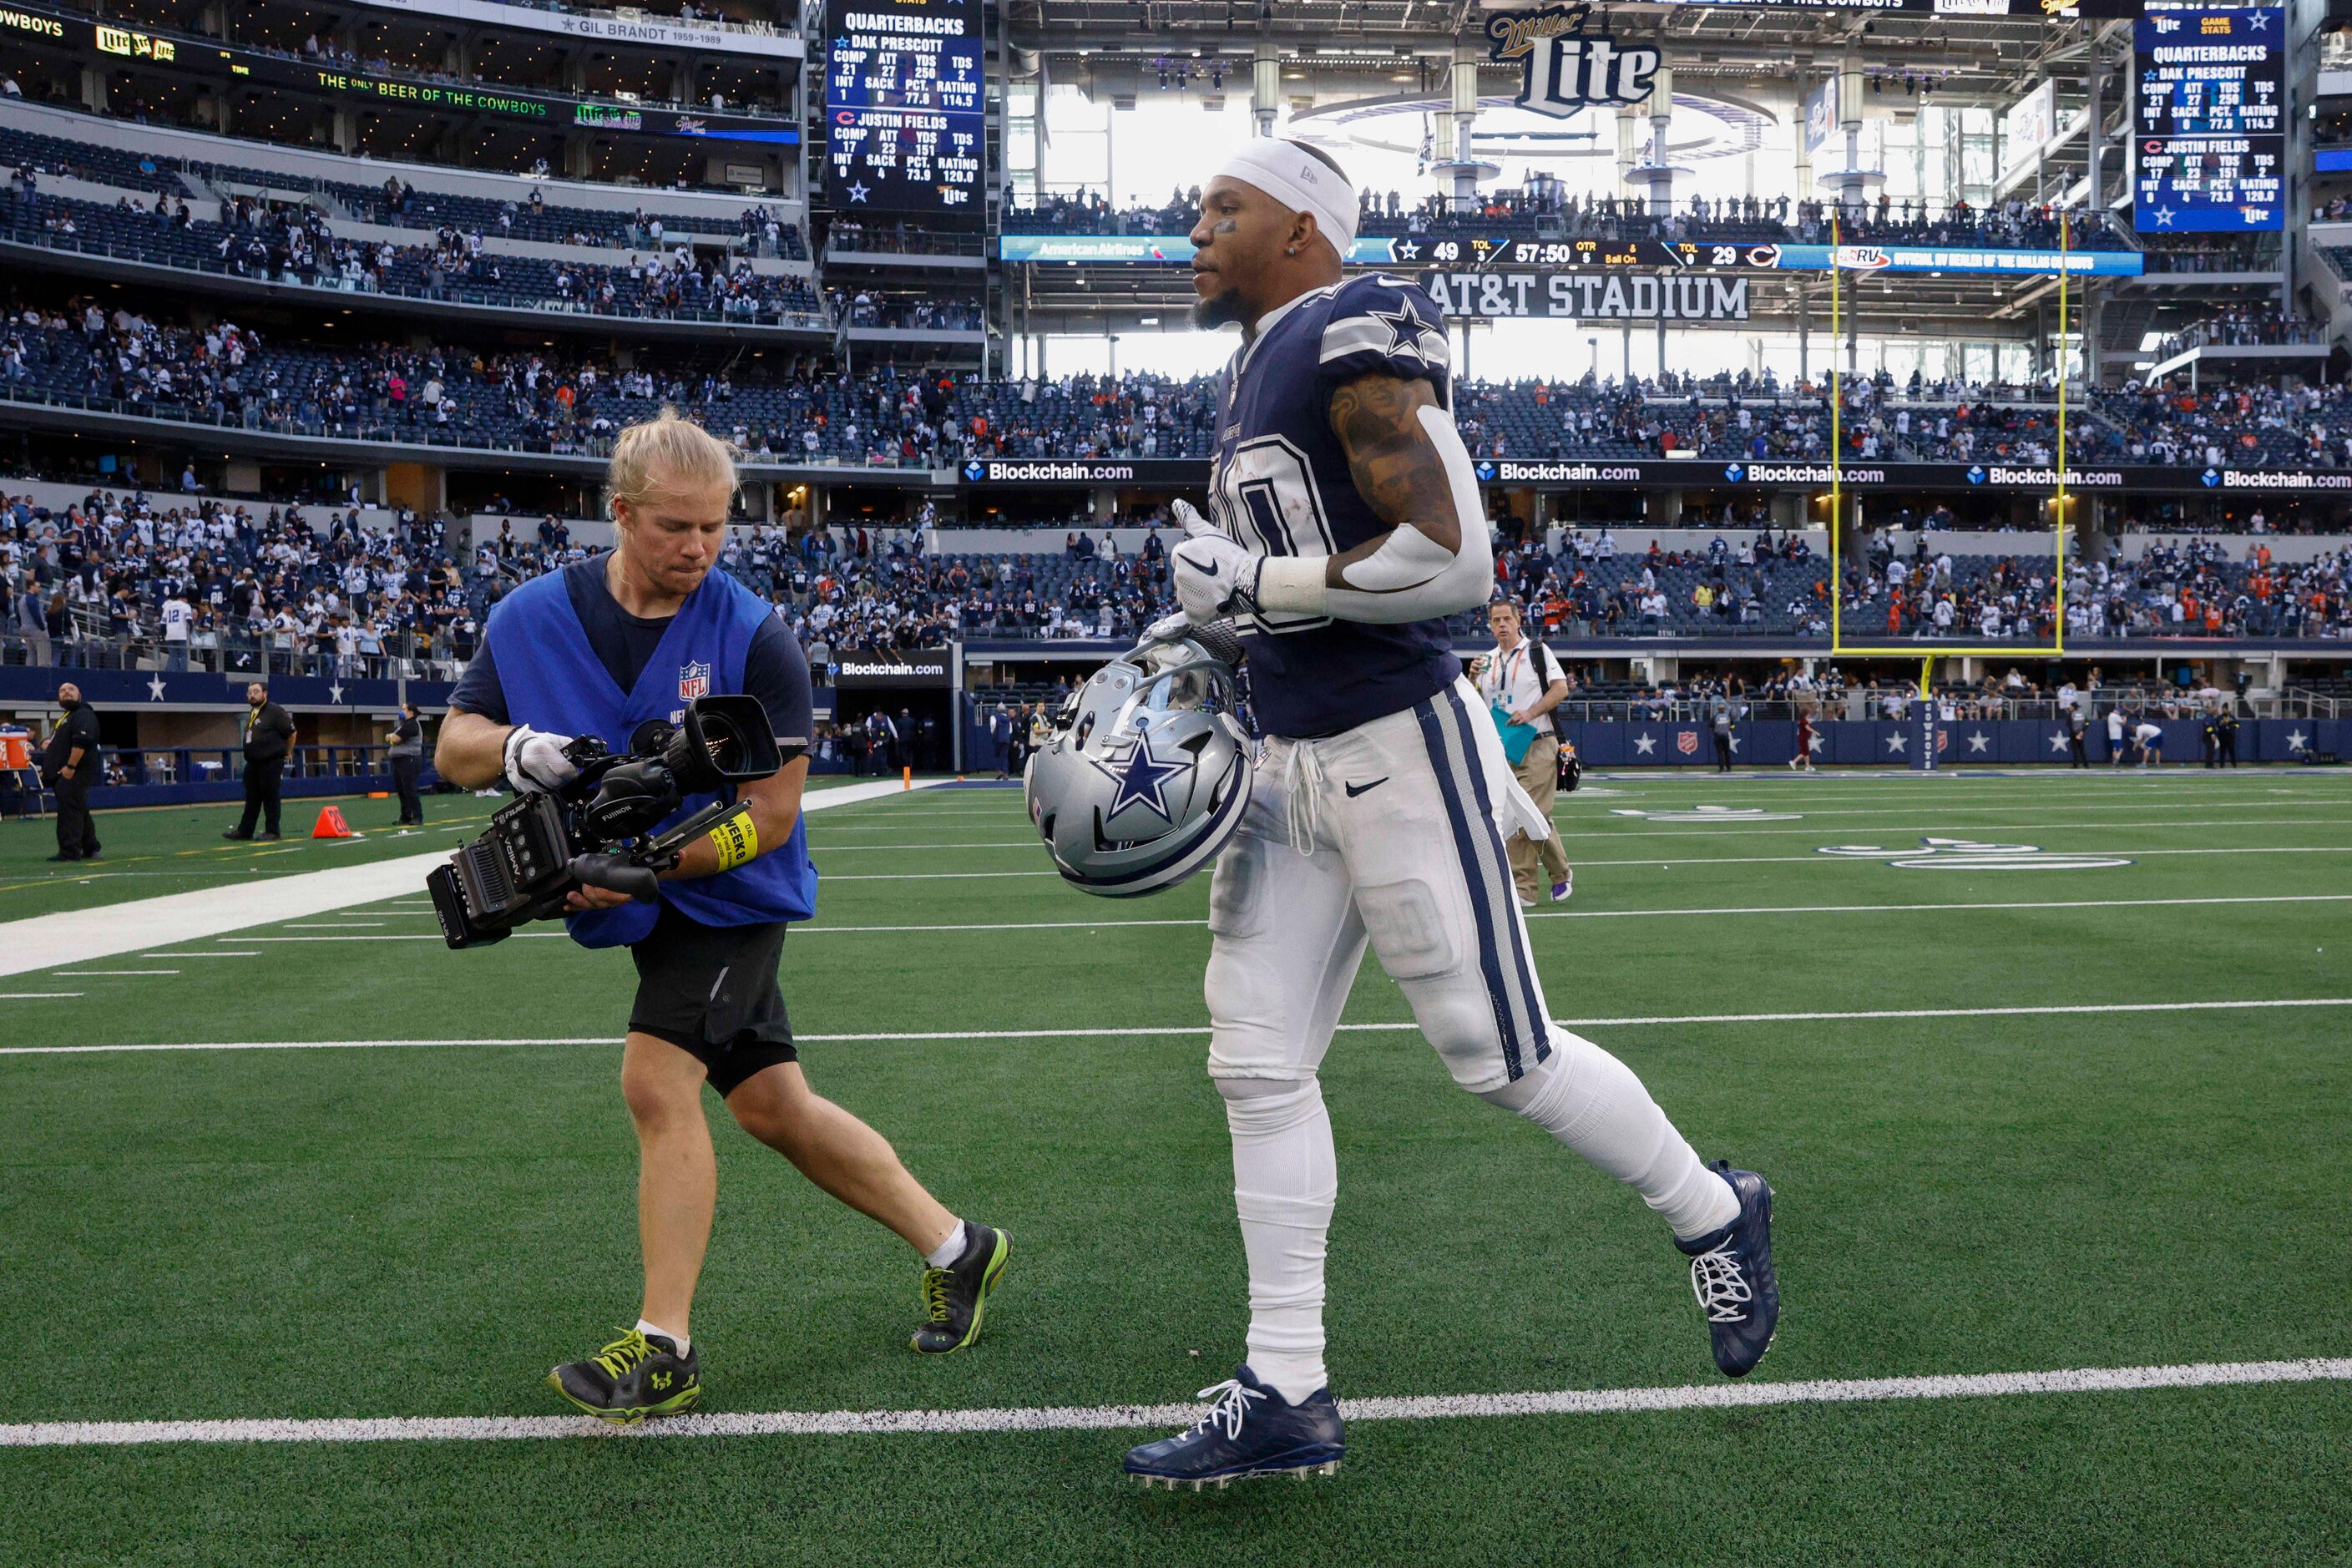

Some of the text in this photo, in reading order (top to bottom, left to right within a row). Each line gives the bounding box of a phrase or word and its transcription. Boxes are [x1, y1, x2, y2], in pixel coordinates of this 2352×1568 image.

[846, 13, 964, 35] QUARTERBACKS
[2157, 19, 2180, 33] Lite
[2201, 18, 2229, 26] GAME
[579, 21, 721, 45] GIL BRANDT 1959-1989
[1491, 13, 1583, 51] Miller
[2201, 26, 2231, 34] STATS
[852, 35, 943, 52] DAK PRESCOTT
[834, 50, 972, 68] COMP ATT YDS TDS
[2153, 46, 2267, 63] QUARTERBACKS
[232, 65, 249, 75] TIME
[842, 64, 965, 80] 21 27 250 2
[1521, 37, 1657, 117] Lite
[2159, 67, 2246, 80] DAK PRESCOTT
[836, 76, 976, 94] INT SACK PCT. RATING
[2142, 82, 2274, 94] COMP ATT YDS TDS
[318, 73, 546, 116] THE ONLY BEER OF THE COWBOYS
[841, 89, 973, 107] 1 0 77.8 114.5
[2151, 94, 2268, 106] 21 27 250 2
[2143, 105, 2278, 118] INT SACK PCT. RATING
[858, 114, 947, 129] JUSTIN FIELDS
[2148, 119, 2274, 130] 1 0 77.8 114.5
[835, 129, 973, 145] COMP ATT YDS TDS
[843, 141, 964, 157] 17 23 151 2
[2164, 140, 2249, 154] JUSTIN FIELDS
[834, 153, 978, 170] INT SACK PCT. RATING
[2142, 155, 2274, 167] COMP ATT YDS TDS
[840, 165, 974, 183] 0 4 73.9 120.0
[2150, 168, 2266, 180] 17 23 151 2
[2142, 179, 2279, 190] INT SACK PCT. RATING
[943, 189, 968, 205] Lite
[2147, 191, 2274, 203] 0 4 73.9 120.0
[2244, 209, 2269, 224] Lite
[1039, 243, 1144, 255] American Airlines
[1434, 242, 1736, 265] 49 57:50 29
[1472, 240, 1490, 250] TOL
[1630, 245, 1636, 253] &
[1679, 244, 1697, 253] TOL
[1478, 252, 1485, 262] 3
[1583, 253, 1590, 263] 5
[1624, 255, 1636, 264] On
[1687, 255, 1694, 265] 0
[1857, 249, 1879, 262] RV
[1894, 253, 1934, 266] OFFICIAL
[1950, 254, 1982, 267] DEALER
[1983, 255, 1995, 267] OF
[1998, 255, 2016, 268] THE
[2016, 255, 2050, 269] DALLAS
[1429, 275, 1748, 318] AT&T STADIUM
[989, 463, 1133, 480] Blockchain.com
[1500, 463, 1640, 480] Blockchain.com
[2223, 470, 2350, 488] Blockchain.com
[210, 591, 223, 604] 88
[168, 609, 180, 622] 12
[343, 632, 349, 641] 4
[842, 662, 943, 675] Blockchain.com
[681, 678, 705, 697] NFL
[505, 802, 526, 820] FILMS
[601, 805, 632, 822] FUJINON
[328, 810, 348, 833] 20
[745, 824, 753, 838] DAL
[722, 837, 731, 851] Field
[504, 836, 521, 876] AMIRA
[736, 851, 746, 860] 8
